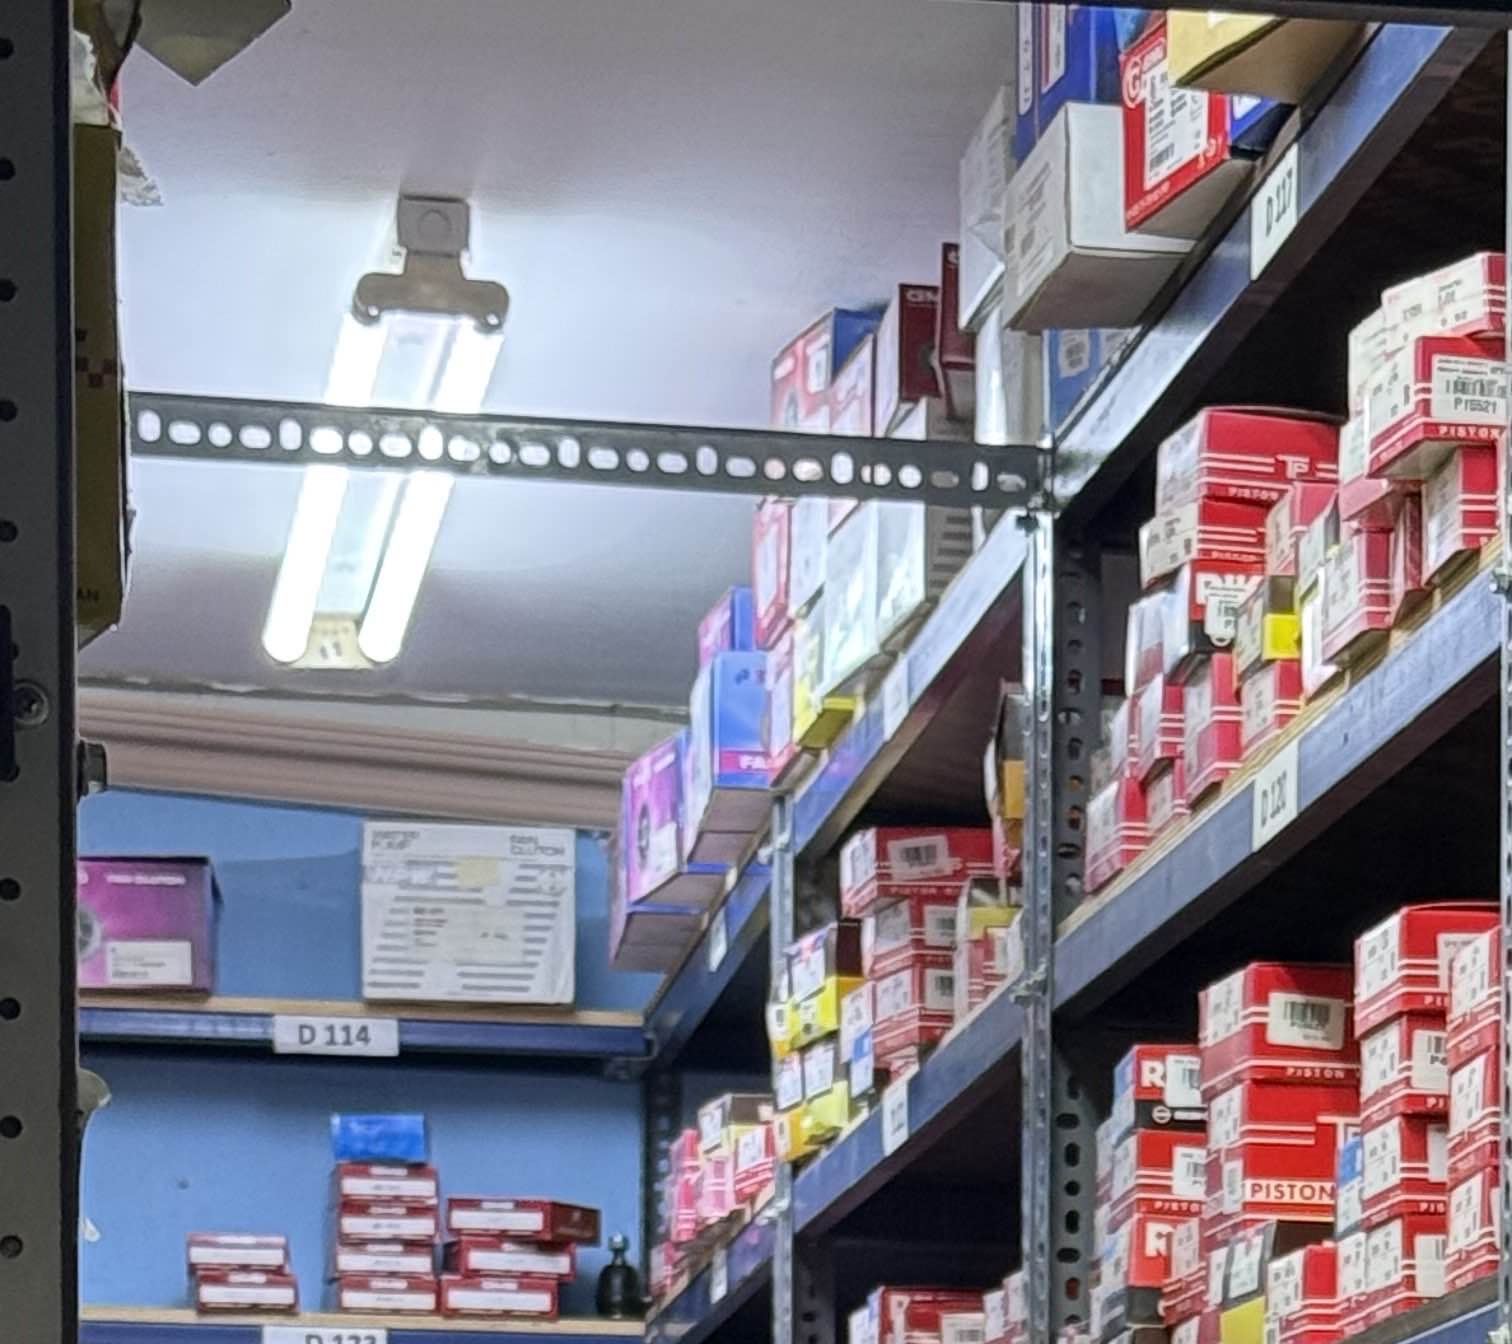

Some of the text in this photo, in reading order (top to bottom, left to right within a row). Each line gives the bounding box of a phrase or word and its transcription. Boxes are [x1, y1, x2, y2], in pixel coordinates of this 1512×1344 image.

[1265, 195, 1274, 237] D
[1260, 791, 1267, 829] D
[299, 1024, 371, 1047] D 114
[1249, 1181, 1336, 1202] PISTON
